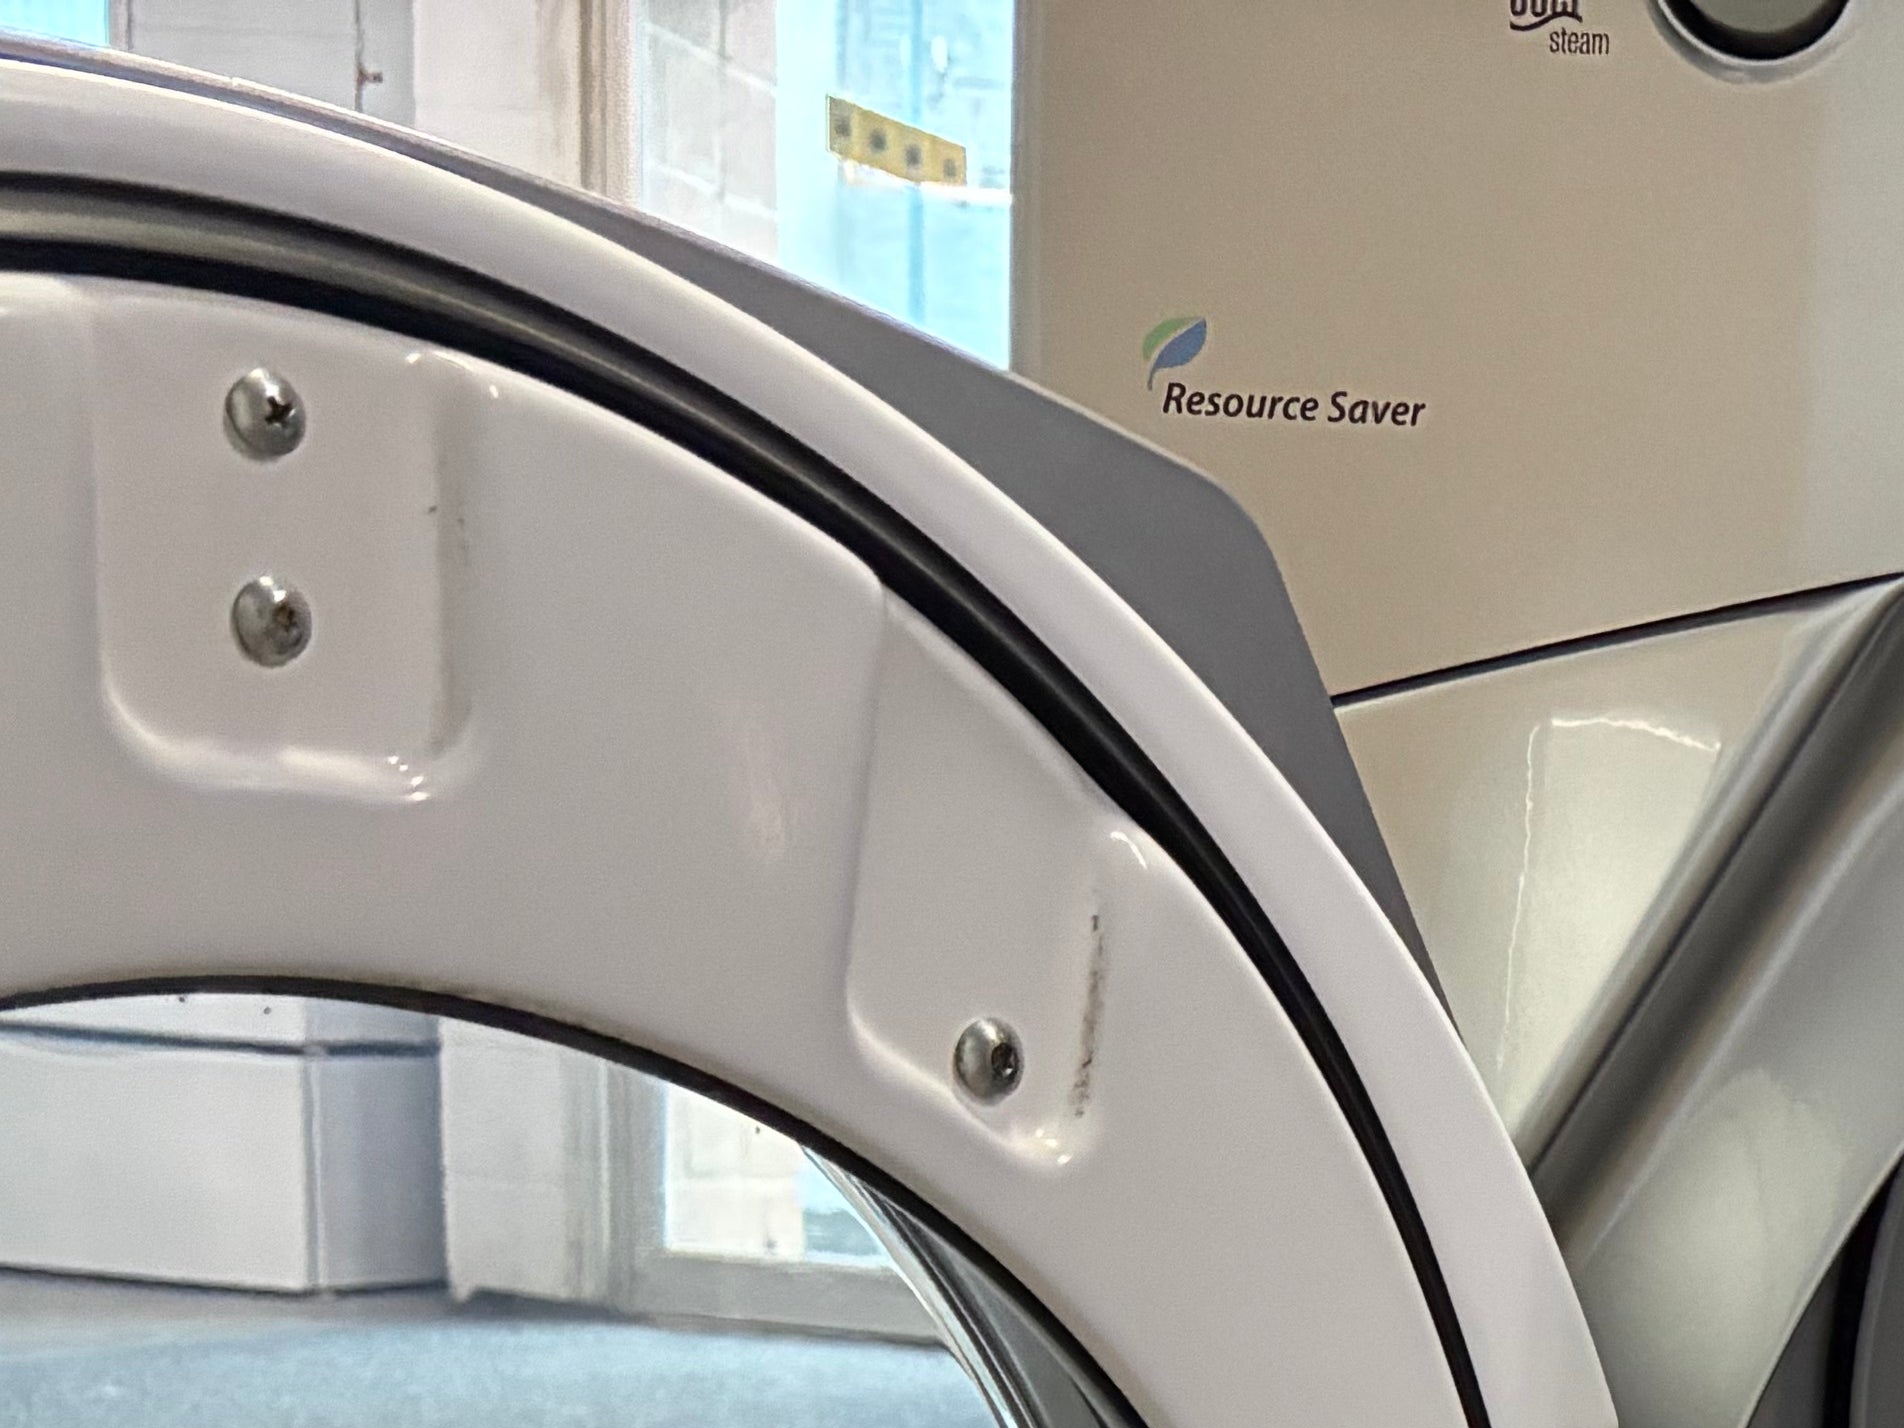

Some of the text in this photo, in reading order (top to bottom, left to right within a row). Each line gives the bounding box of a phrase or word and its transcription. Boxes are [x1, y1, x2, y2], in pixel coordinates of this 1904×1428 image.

[1550, 27, 1610, 55] steam
[1162, 382, 1426, 426] Resource Saver
